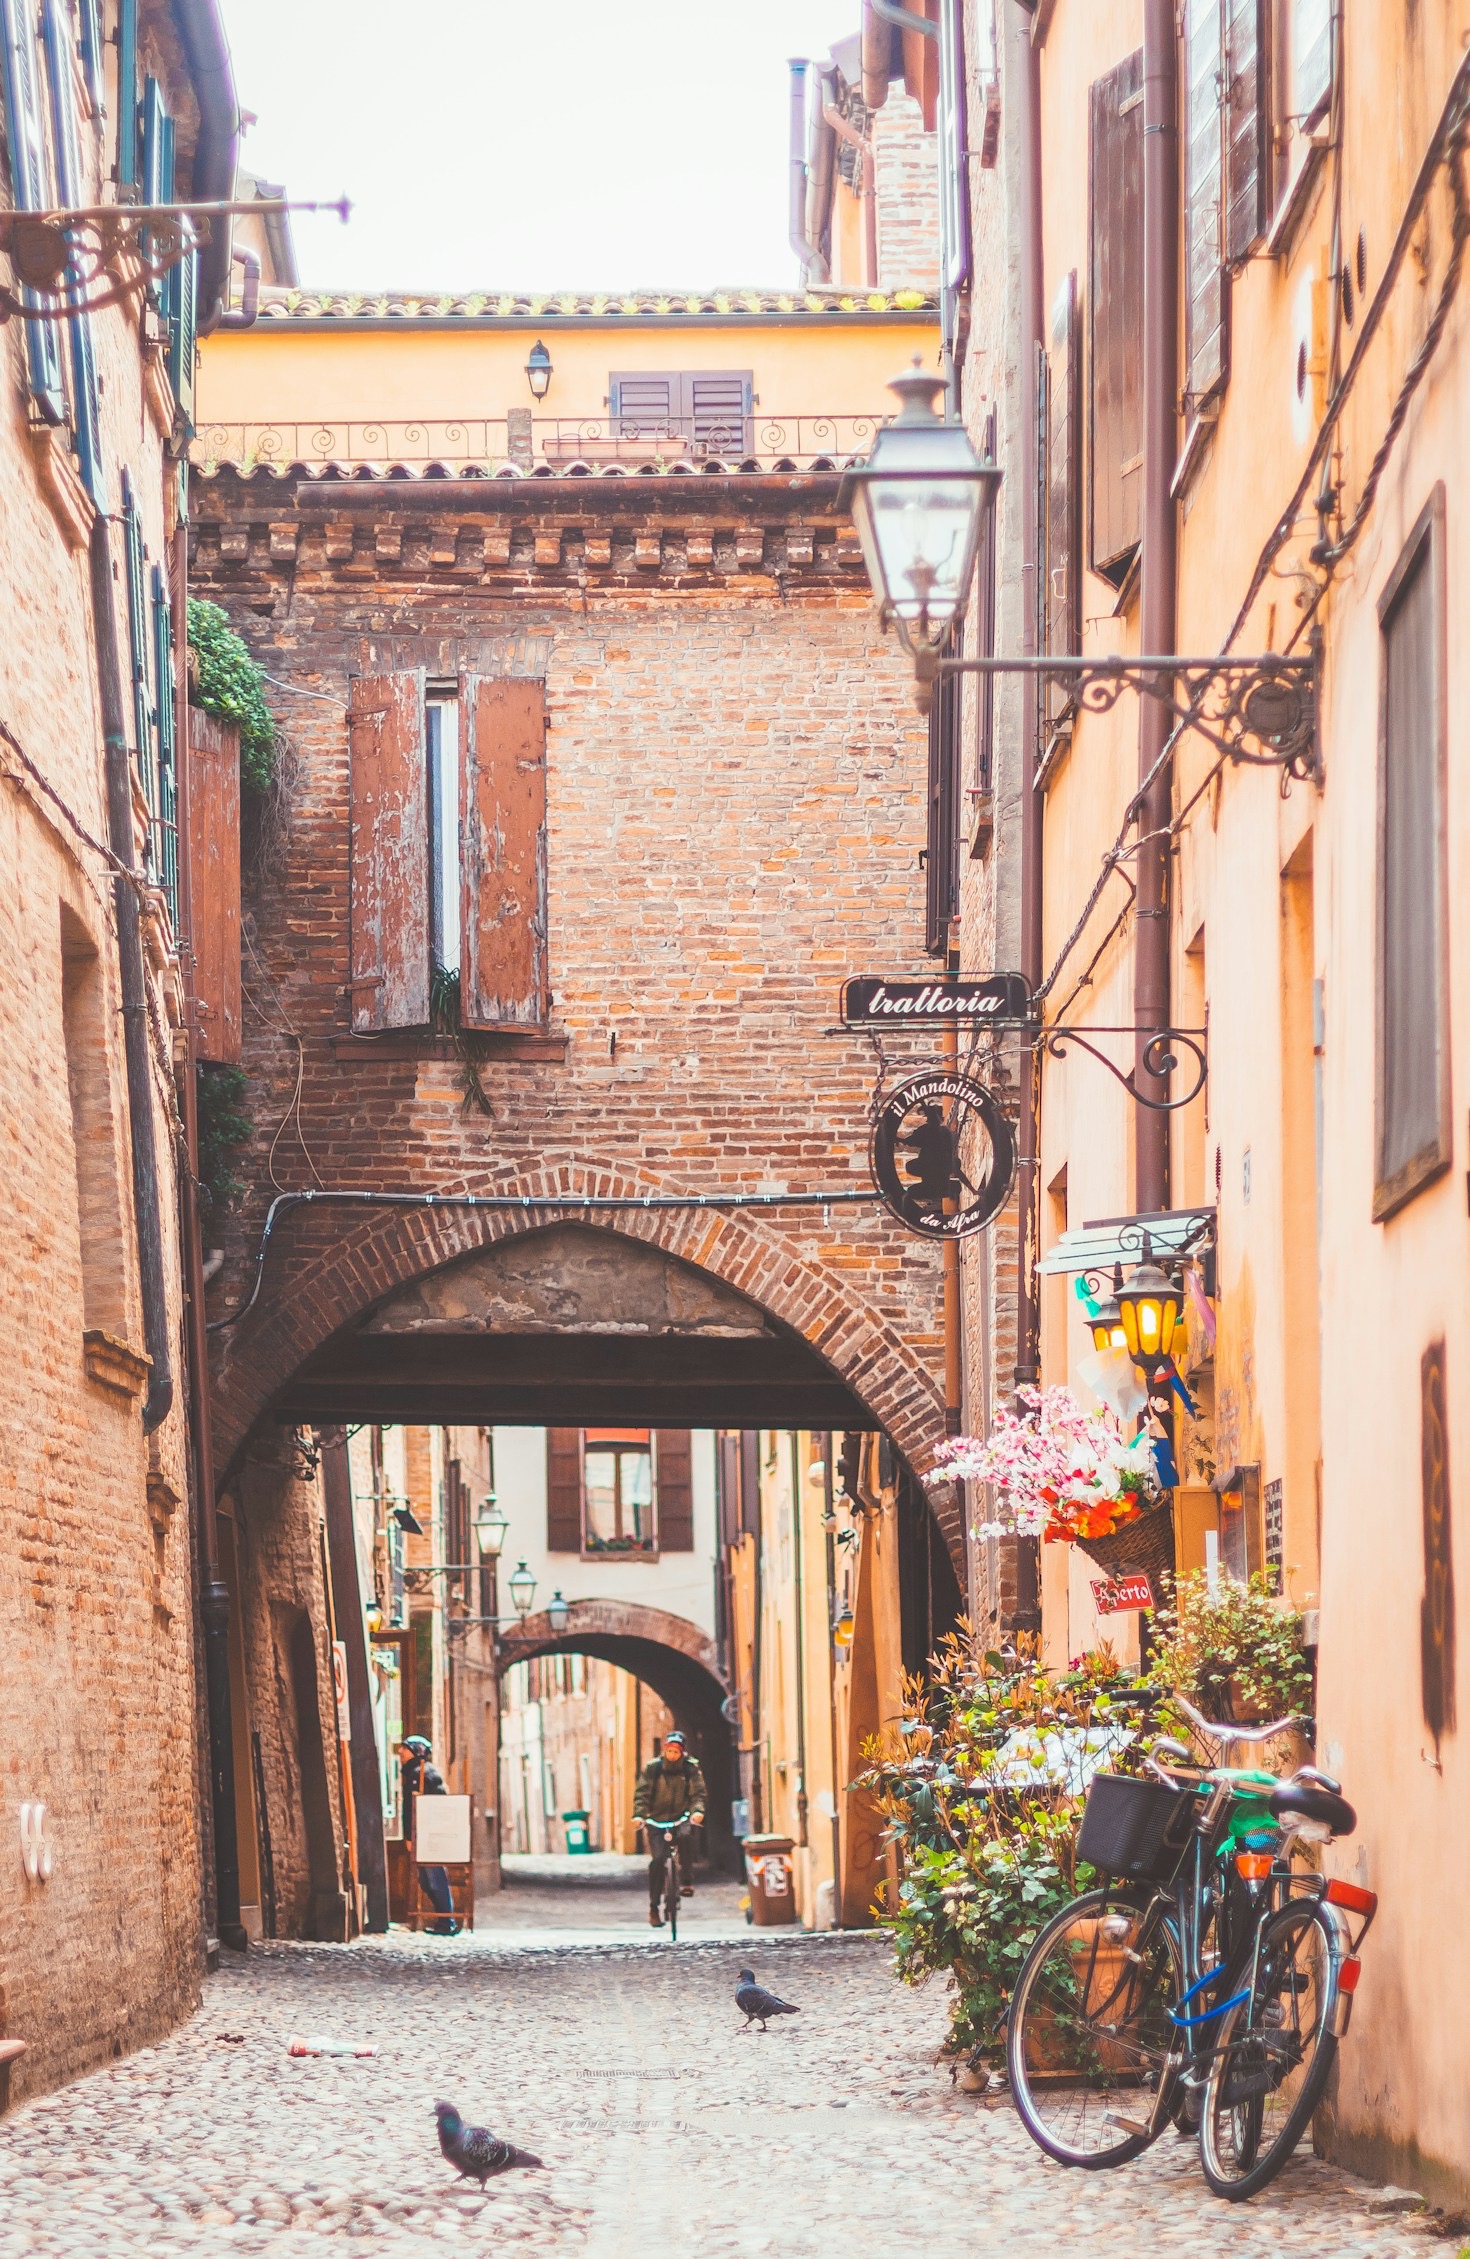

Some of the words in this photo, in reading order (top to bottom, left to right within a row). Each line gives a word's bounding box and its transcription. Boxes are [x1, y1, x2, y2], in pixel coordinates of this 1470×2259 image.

[868, 986, 1006, 1014] trattoria
[890, 1100, 906, 1118] il
[902, 1077, 984, 1107] Mandolino
[919, 1213, 941, 1227] da
[942, 1210, 980, 1233] Afra
